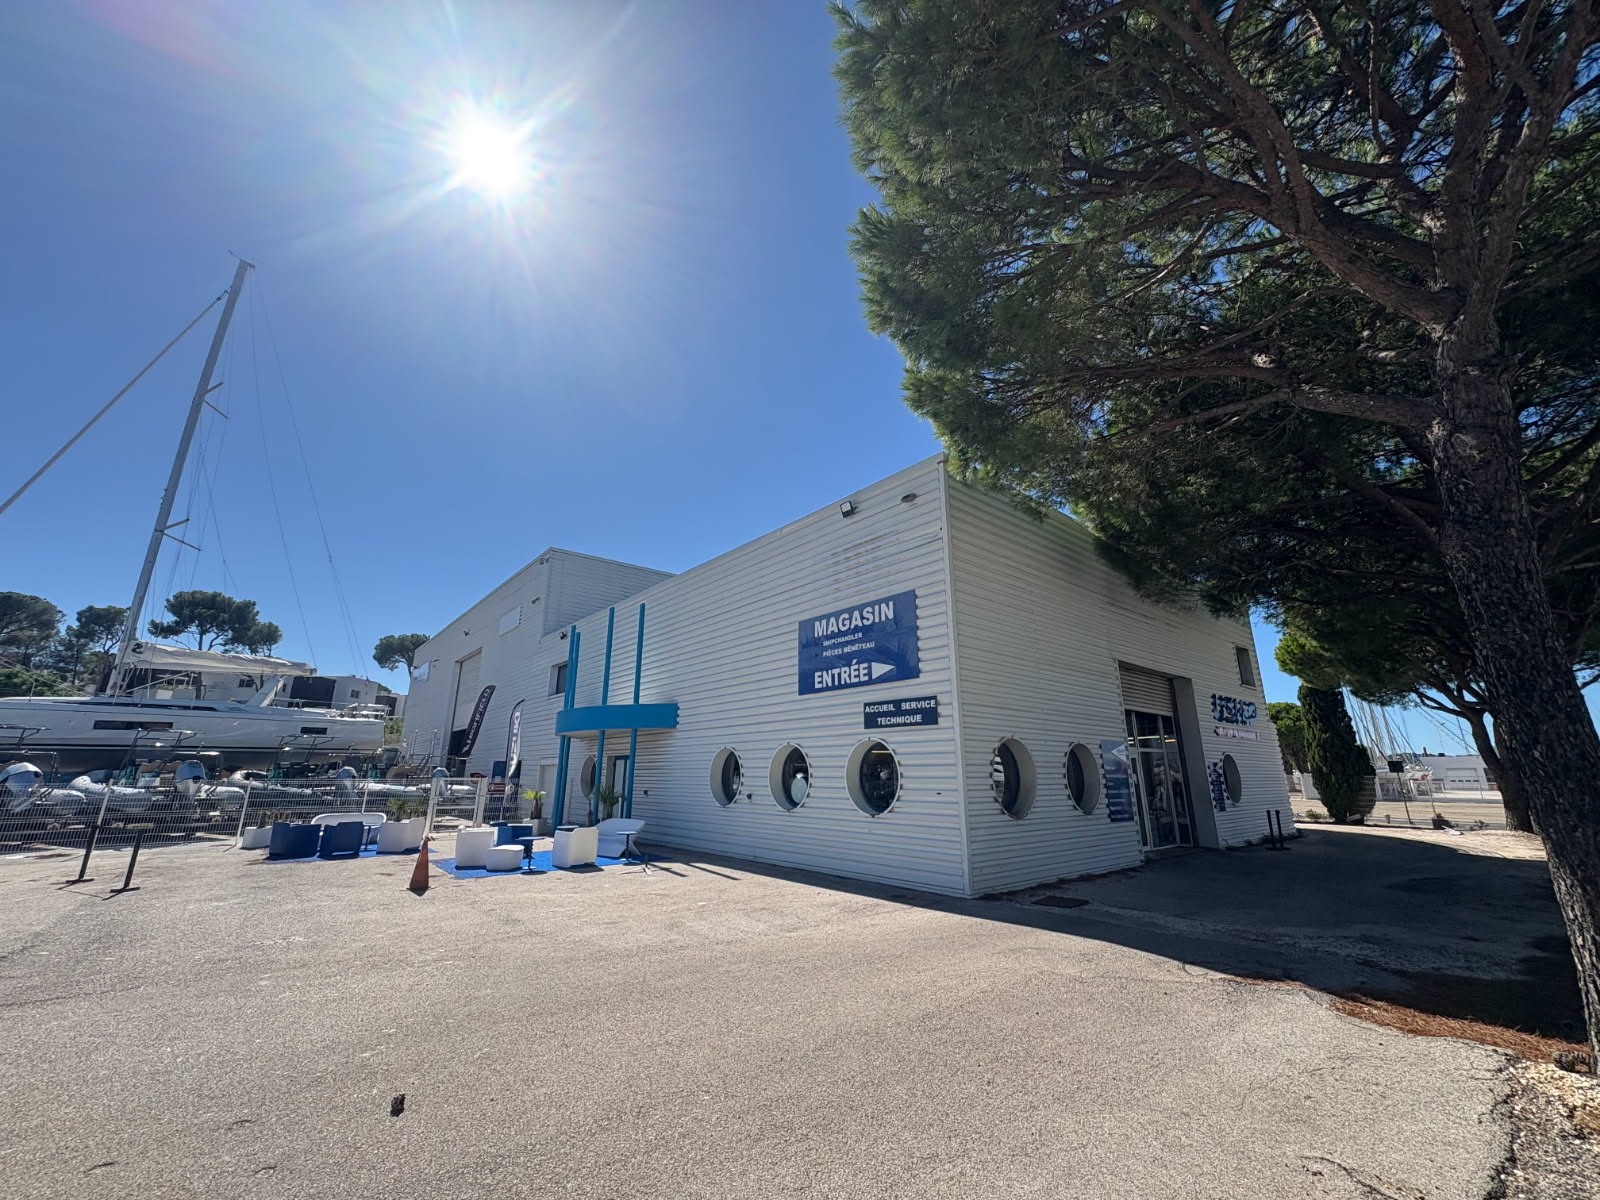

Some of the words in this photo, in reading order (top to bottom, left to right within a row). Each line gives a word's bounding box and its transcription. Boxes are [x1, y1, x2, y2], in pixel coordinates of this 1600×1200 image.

[814, 601, 894, 638] MAGASIN
[823, 632, 863, 647] SHIPCHANDLER
[823, 647, 842, 657] PIÈCES
[814, 659, 869, 689] ENTRÉE
[865, 703, 896, 714] ACCUEIL
[901, 699, 936, 711] SERVICE
[877, 714, 923, 726] TECHNIQUE
